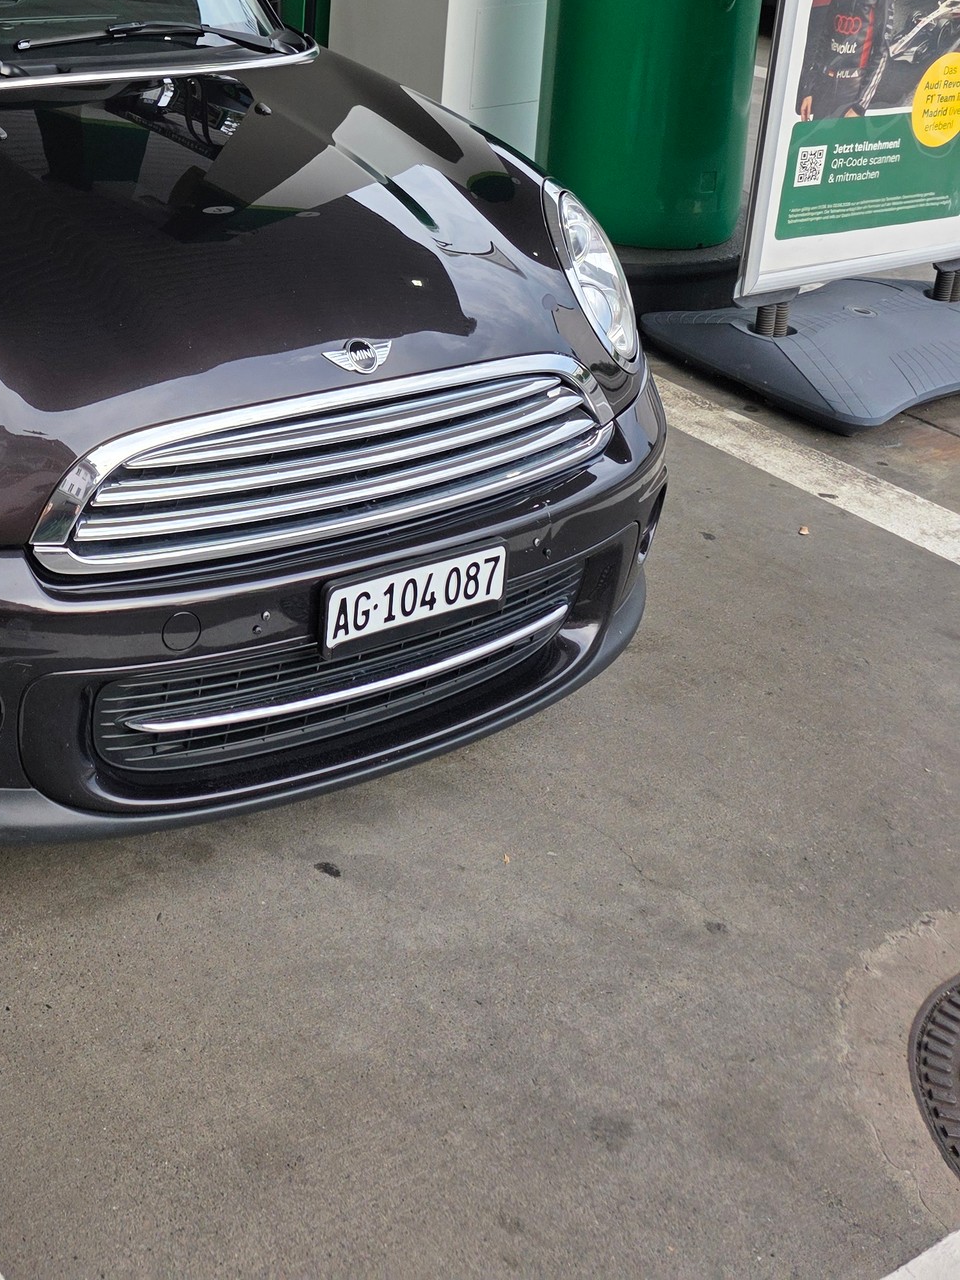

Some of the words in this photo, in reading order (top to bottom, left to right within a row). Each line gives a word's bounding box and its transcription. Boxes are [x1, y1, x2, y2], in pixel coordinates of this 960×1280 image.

[836, 70, 851, 79] HUL
[943, 65, 957, 76] Das
[924, 80, 942, 90] Audi
[936, 93, 955, 103] Team
[922, 106, 948, 118] Madrid
[924, 120, 954, 132] erleben!
[833, 143, 853, 155] Jetzt
[854, 138, 901, 152] teilnehmen!
[831, 156, 868, 169] QR-Code
[869, 153, 901, 166] scannen
[828, 173, 835, 184] &
[835, 169, 880, 183] mitmachen
[351, 349, 375, 361] MINI
[444, 555, 501, 606] 087
